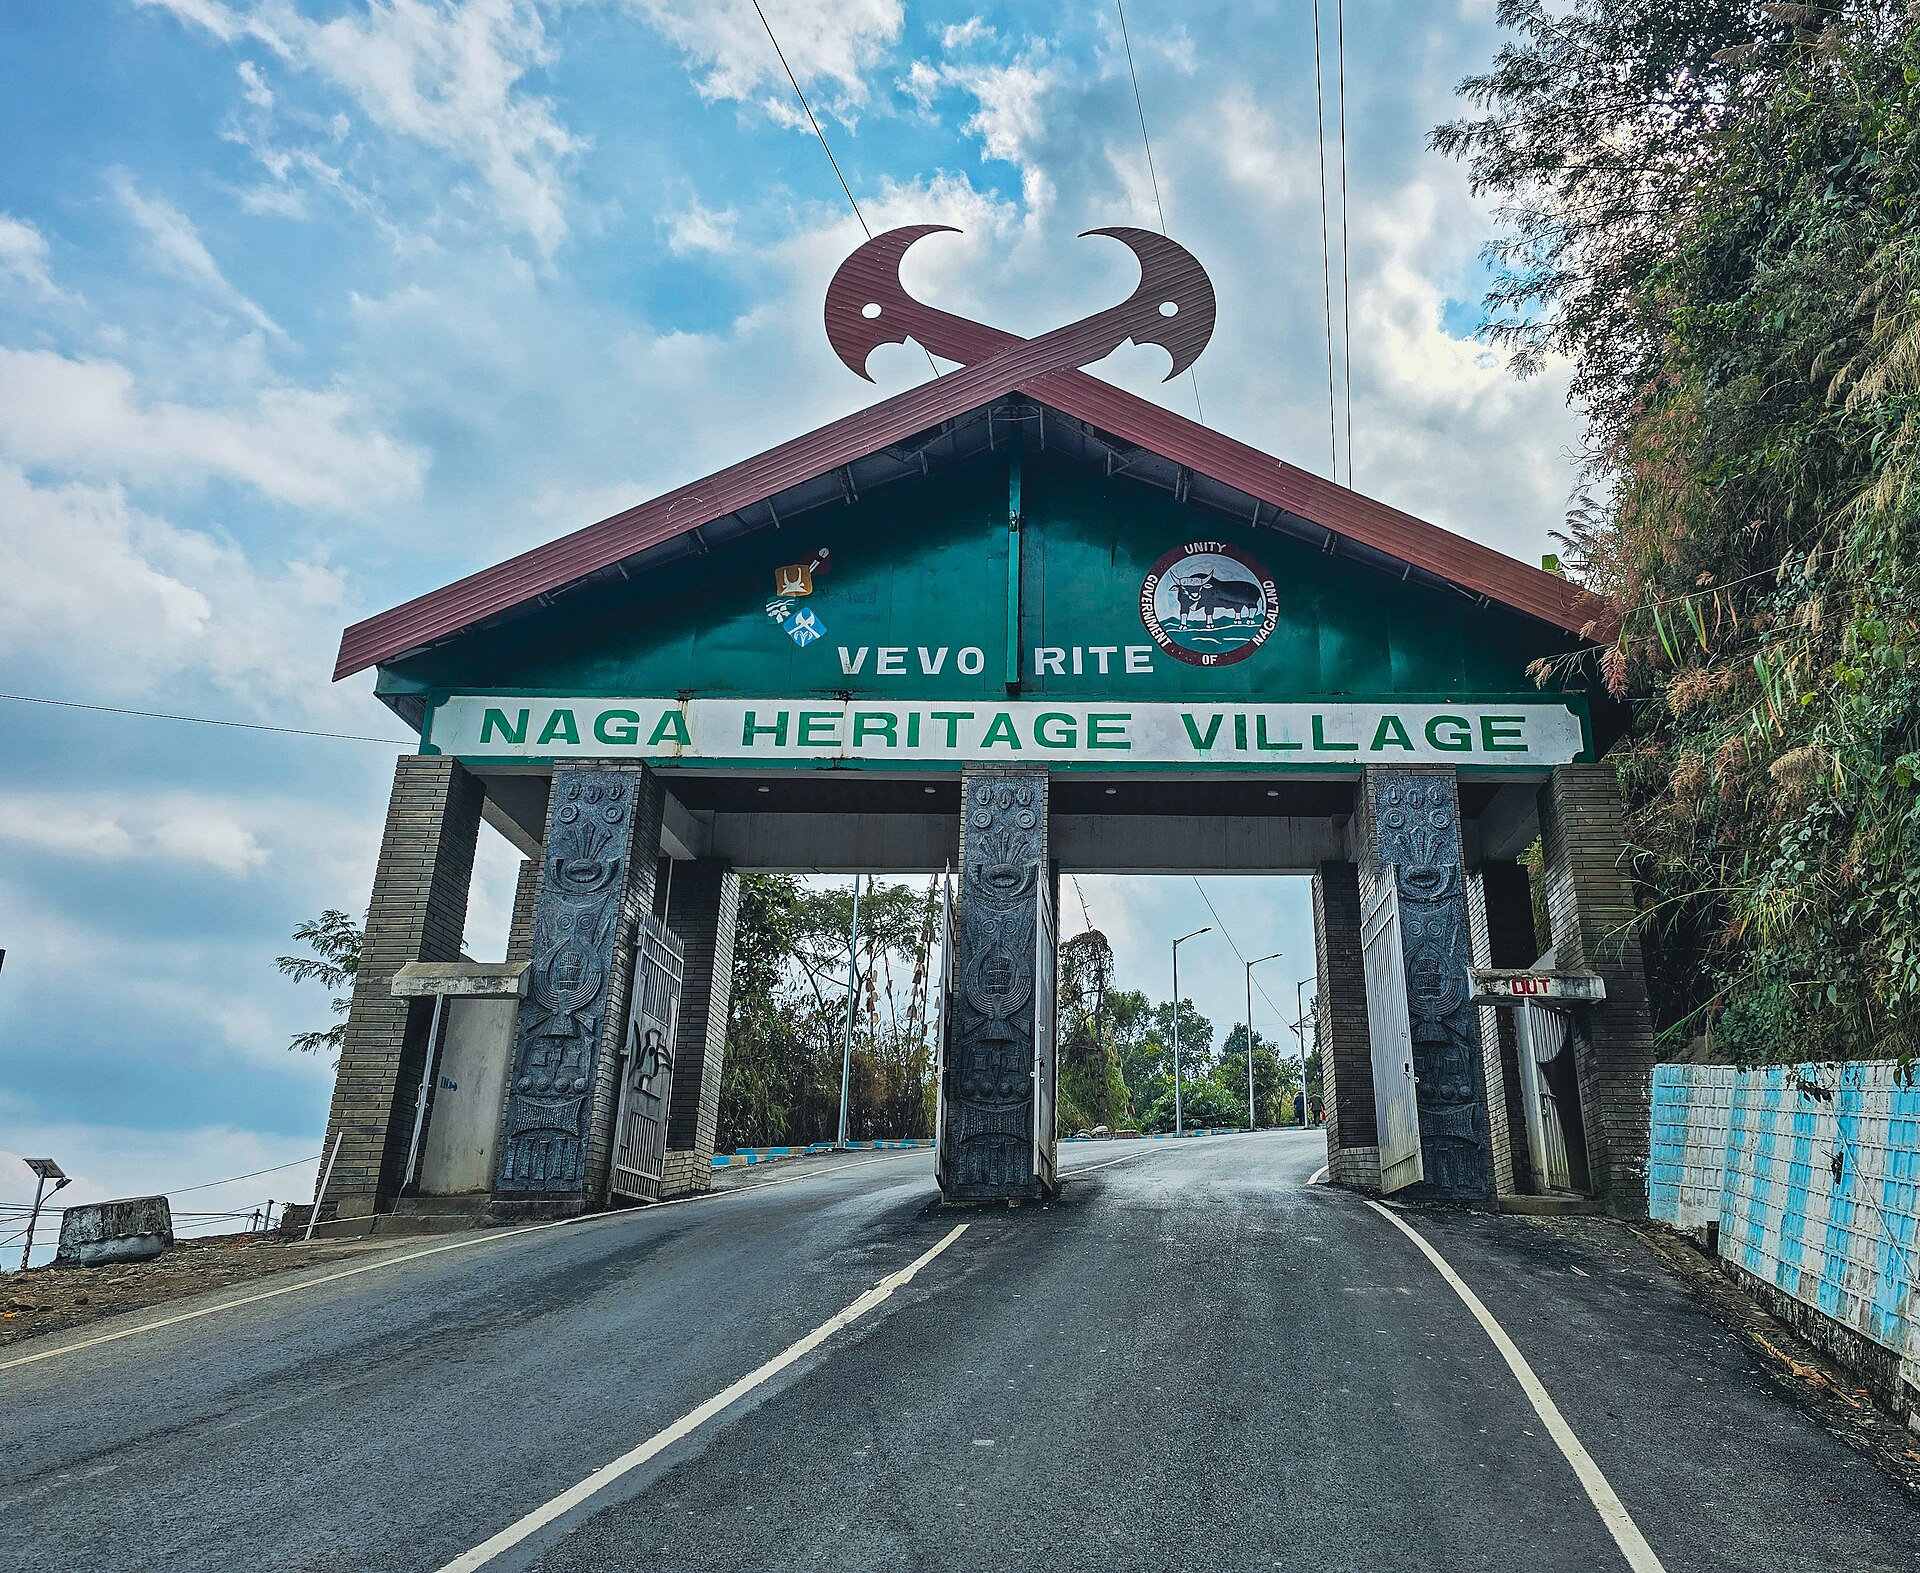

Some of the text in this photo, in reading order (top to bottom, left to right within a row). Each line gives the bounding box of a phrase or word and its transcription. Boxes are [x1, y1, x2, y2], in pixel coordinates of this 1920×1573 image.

[1184, 541, 1227, 554] UNITY
[1141, 574, 1279, 665] GOVERNMENT OF NAGALAND
[837, 646, 1154, 675] VEVO RITE
[479, 708, 1529, 752] NAGA HERITAGE VILLAGE
[1511, 978, 1551, 995] OUT
